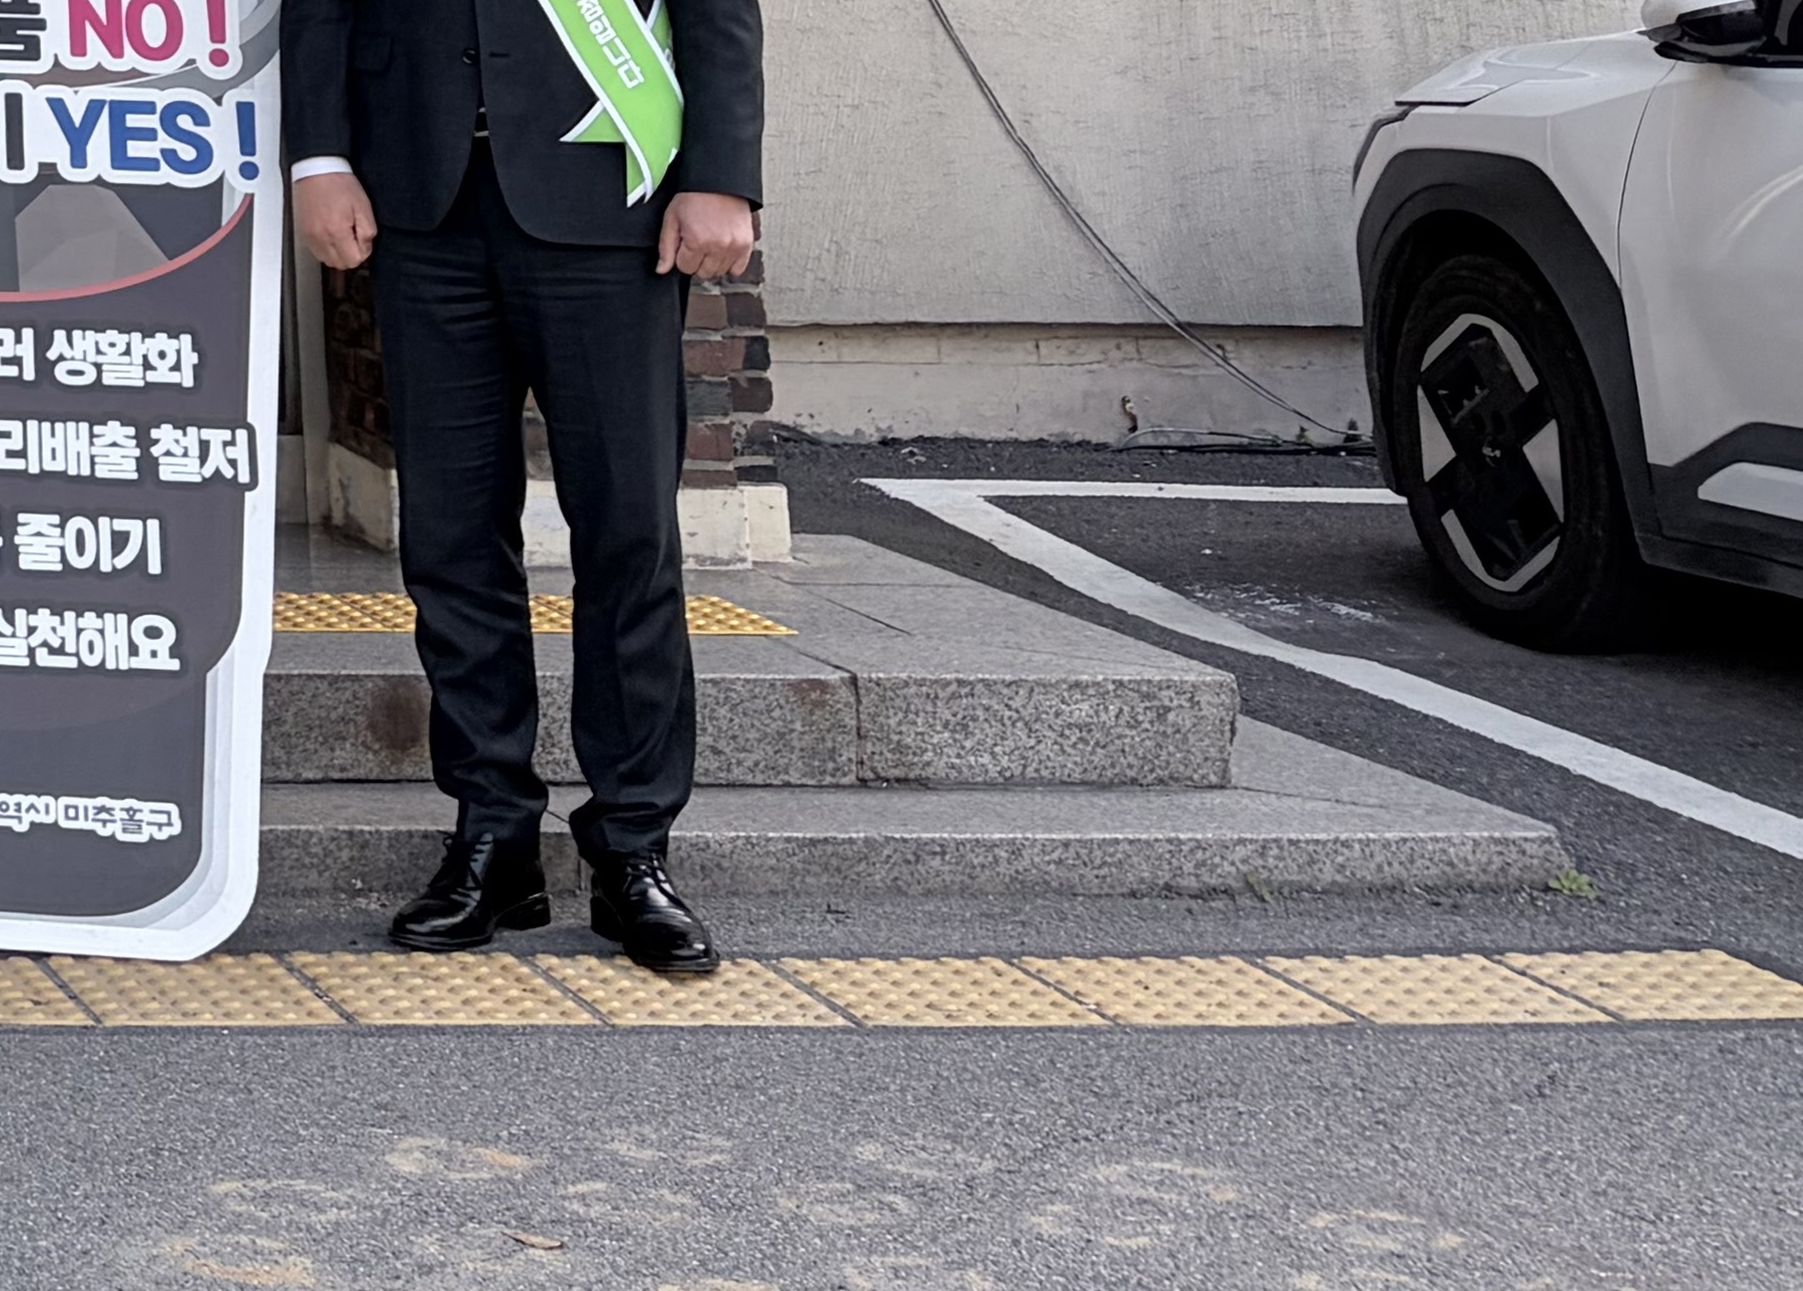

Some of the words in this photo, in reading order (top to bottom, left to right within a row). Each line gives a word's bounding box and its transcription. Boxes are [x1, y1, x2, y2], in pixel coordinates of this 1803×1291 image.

[45, 328, 198, 388] 생활화
[149, 421, 251, 484] 철저
[14, 512, 163, 575] 줄이기
[63, 802, 176, 835] 미추홀구
